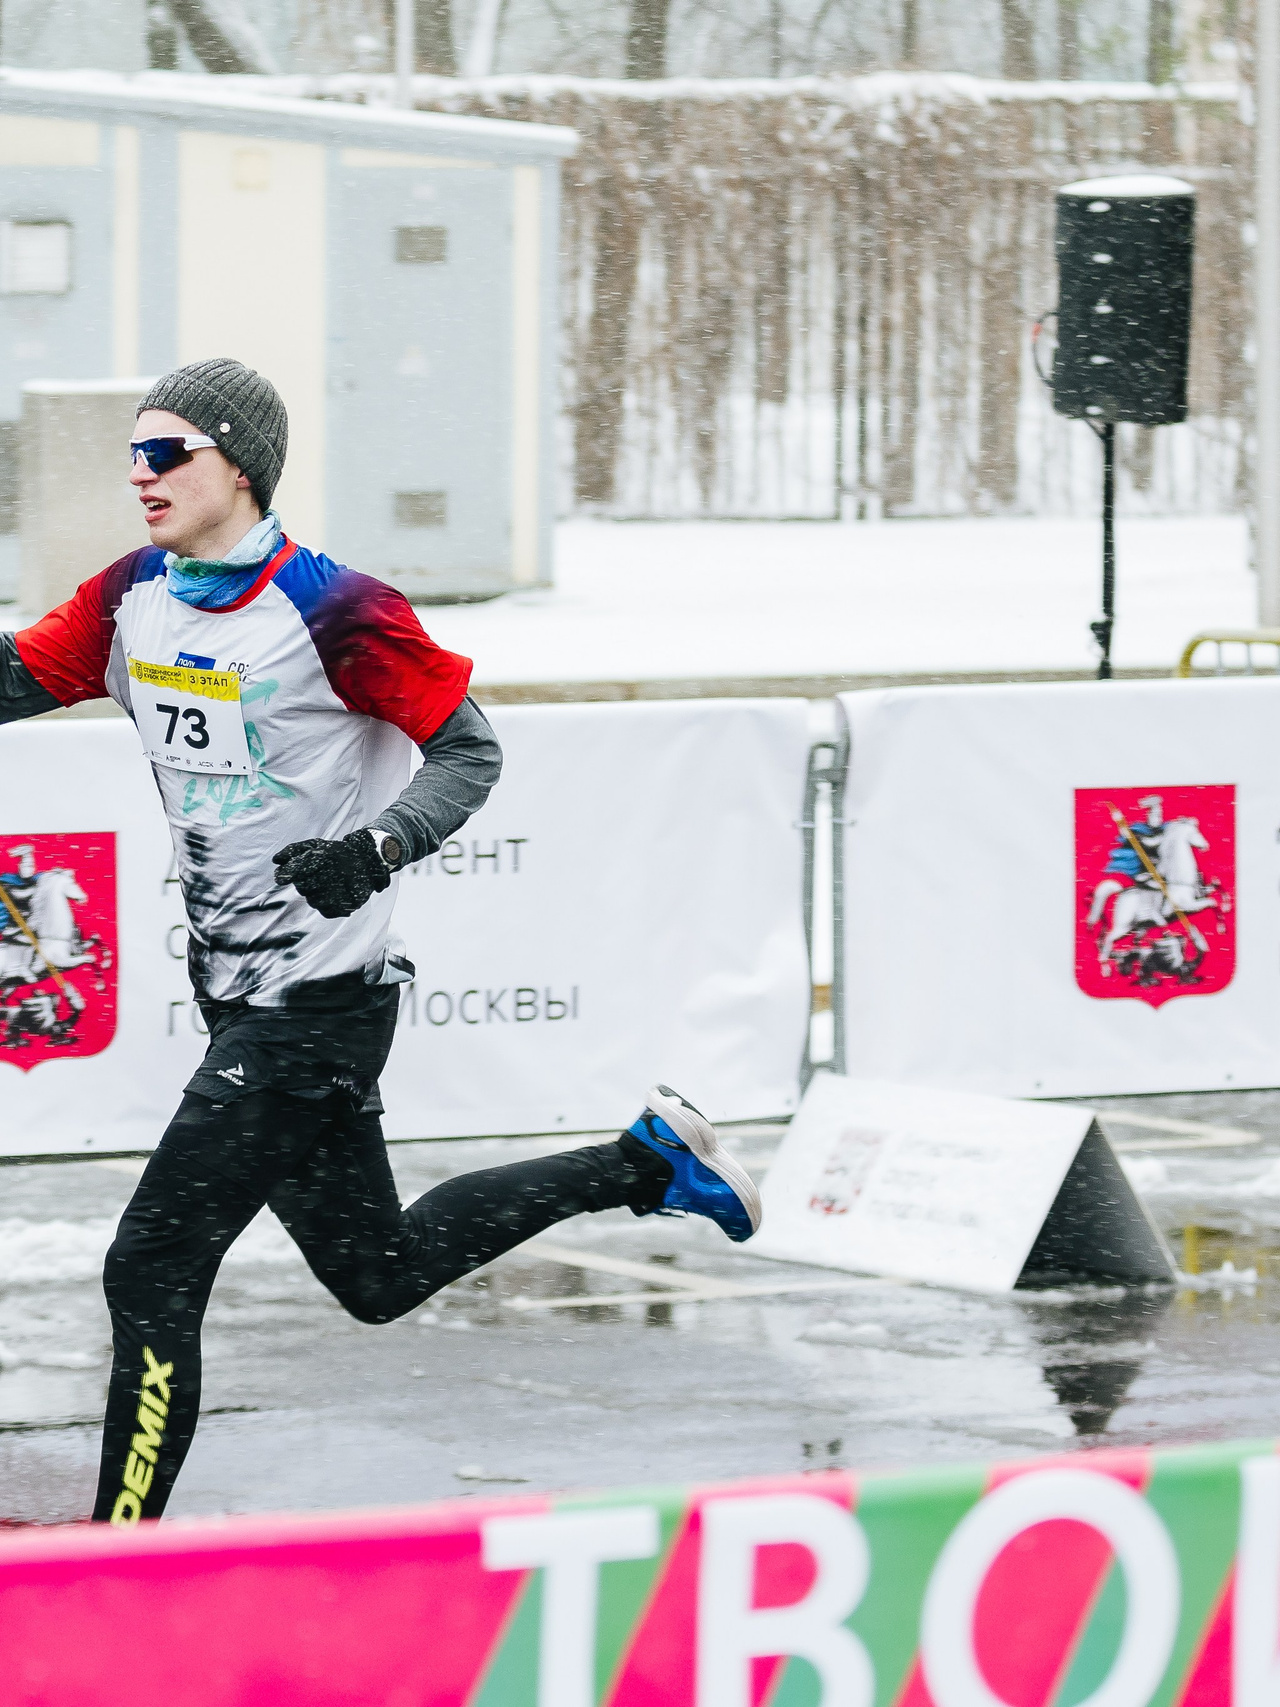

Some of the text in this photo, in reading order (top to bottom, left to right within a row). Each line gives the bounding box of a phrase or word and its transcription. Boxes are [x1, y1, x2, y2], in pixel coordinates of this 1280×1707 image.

[189, 674, 196, 684] 3
[200, 677, 228, 687] ЭТАП
[156, 703, 210, 750] 73
[111, 1346, 174, 1529] DEMIX
